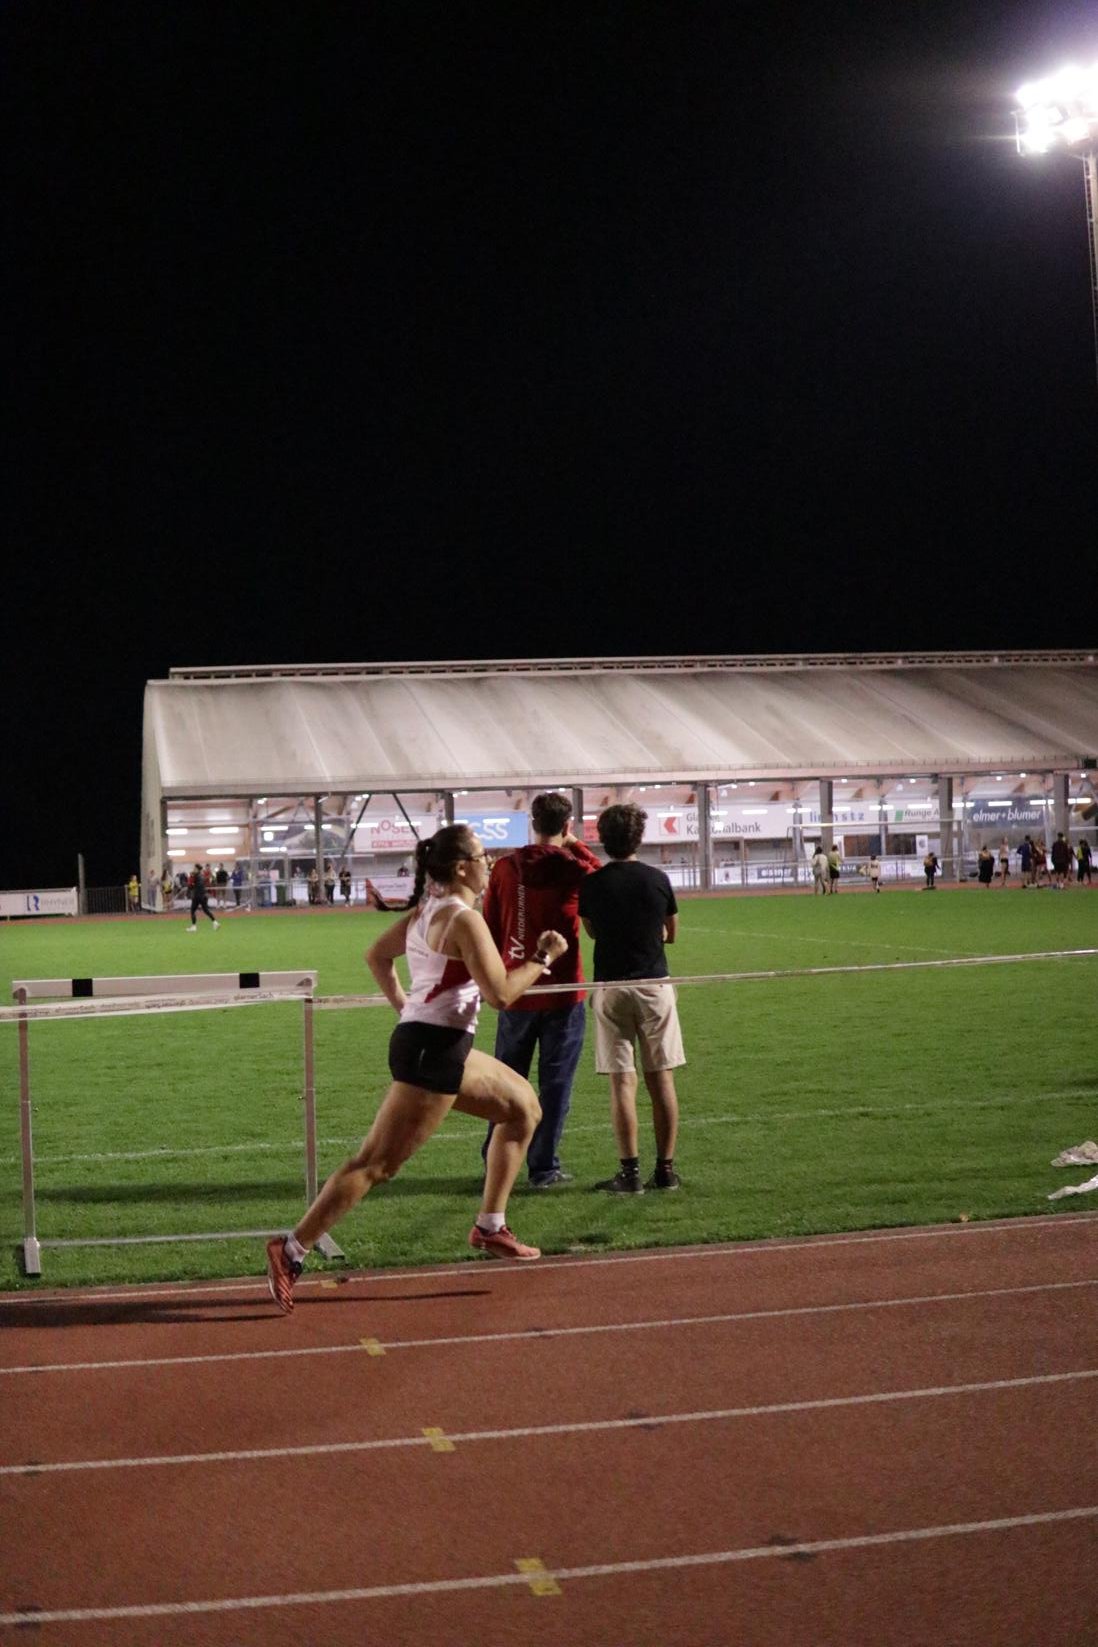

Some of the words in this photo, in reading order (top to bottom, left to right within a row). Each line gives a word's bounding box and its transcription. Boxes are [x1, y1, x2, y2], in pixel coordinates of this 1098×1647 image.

[973, 809, 1000, 822] elmer
[1007, 807, 1041, 821] blumer
[517, 883, 527, 940] NIEDERURNEN
